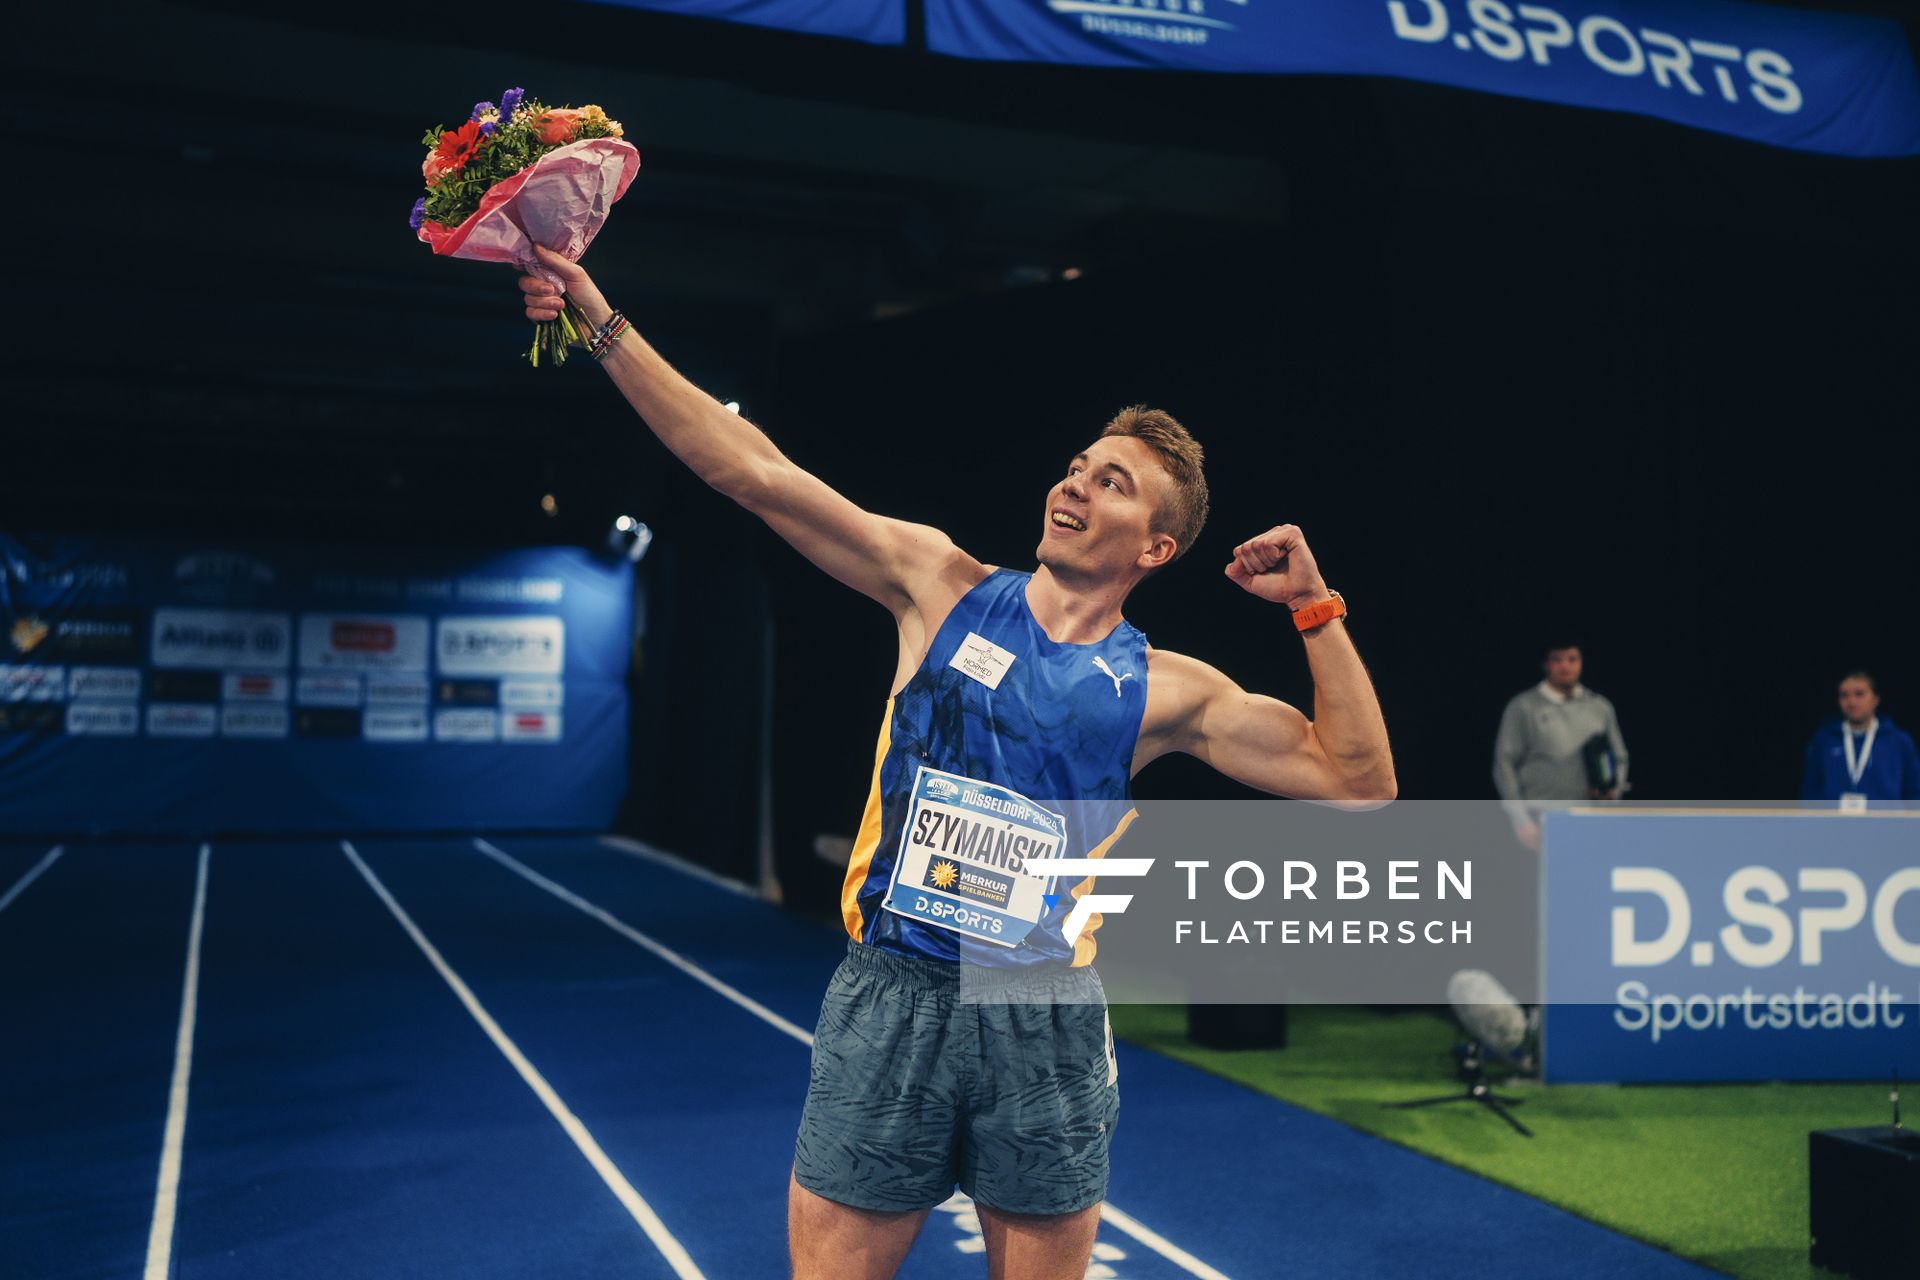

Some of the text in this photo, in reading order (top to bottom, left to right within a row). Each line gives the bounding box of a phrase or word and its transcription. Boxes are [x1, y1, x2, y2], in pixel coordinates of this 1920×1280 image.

[1387, 0, 1803, 115] D.SPORTS
[961, 788, 1032, 821] DÜSSELDORF
[958, 883, 1006, 903] SPIELBANKEN
[960, 871, 1008, 894] MERKUR
[914, 896, 1004, 935] D.SPORTS
[1613, 980, 1905, 1043] Sportstadt
